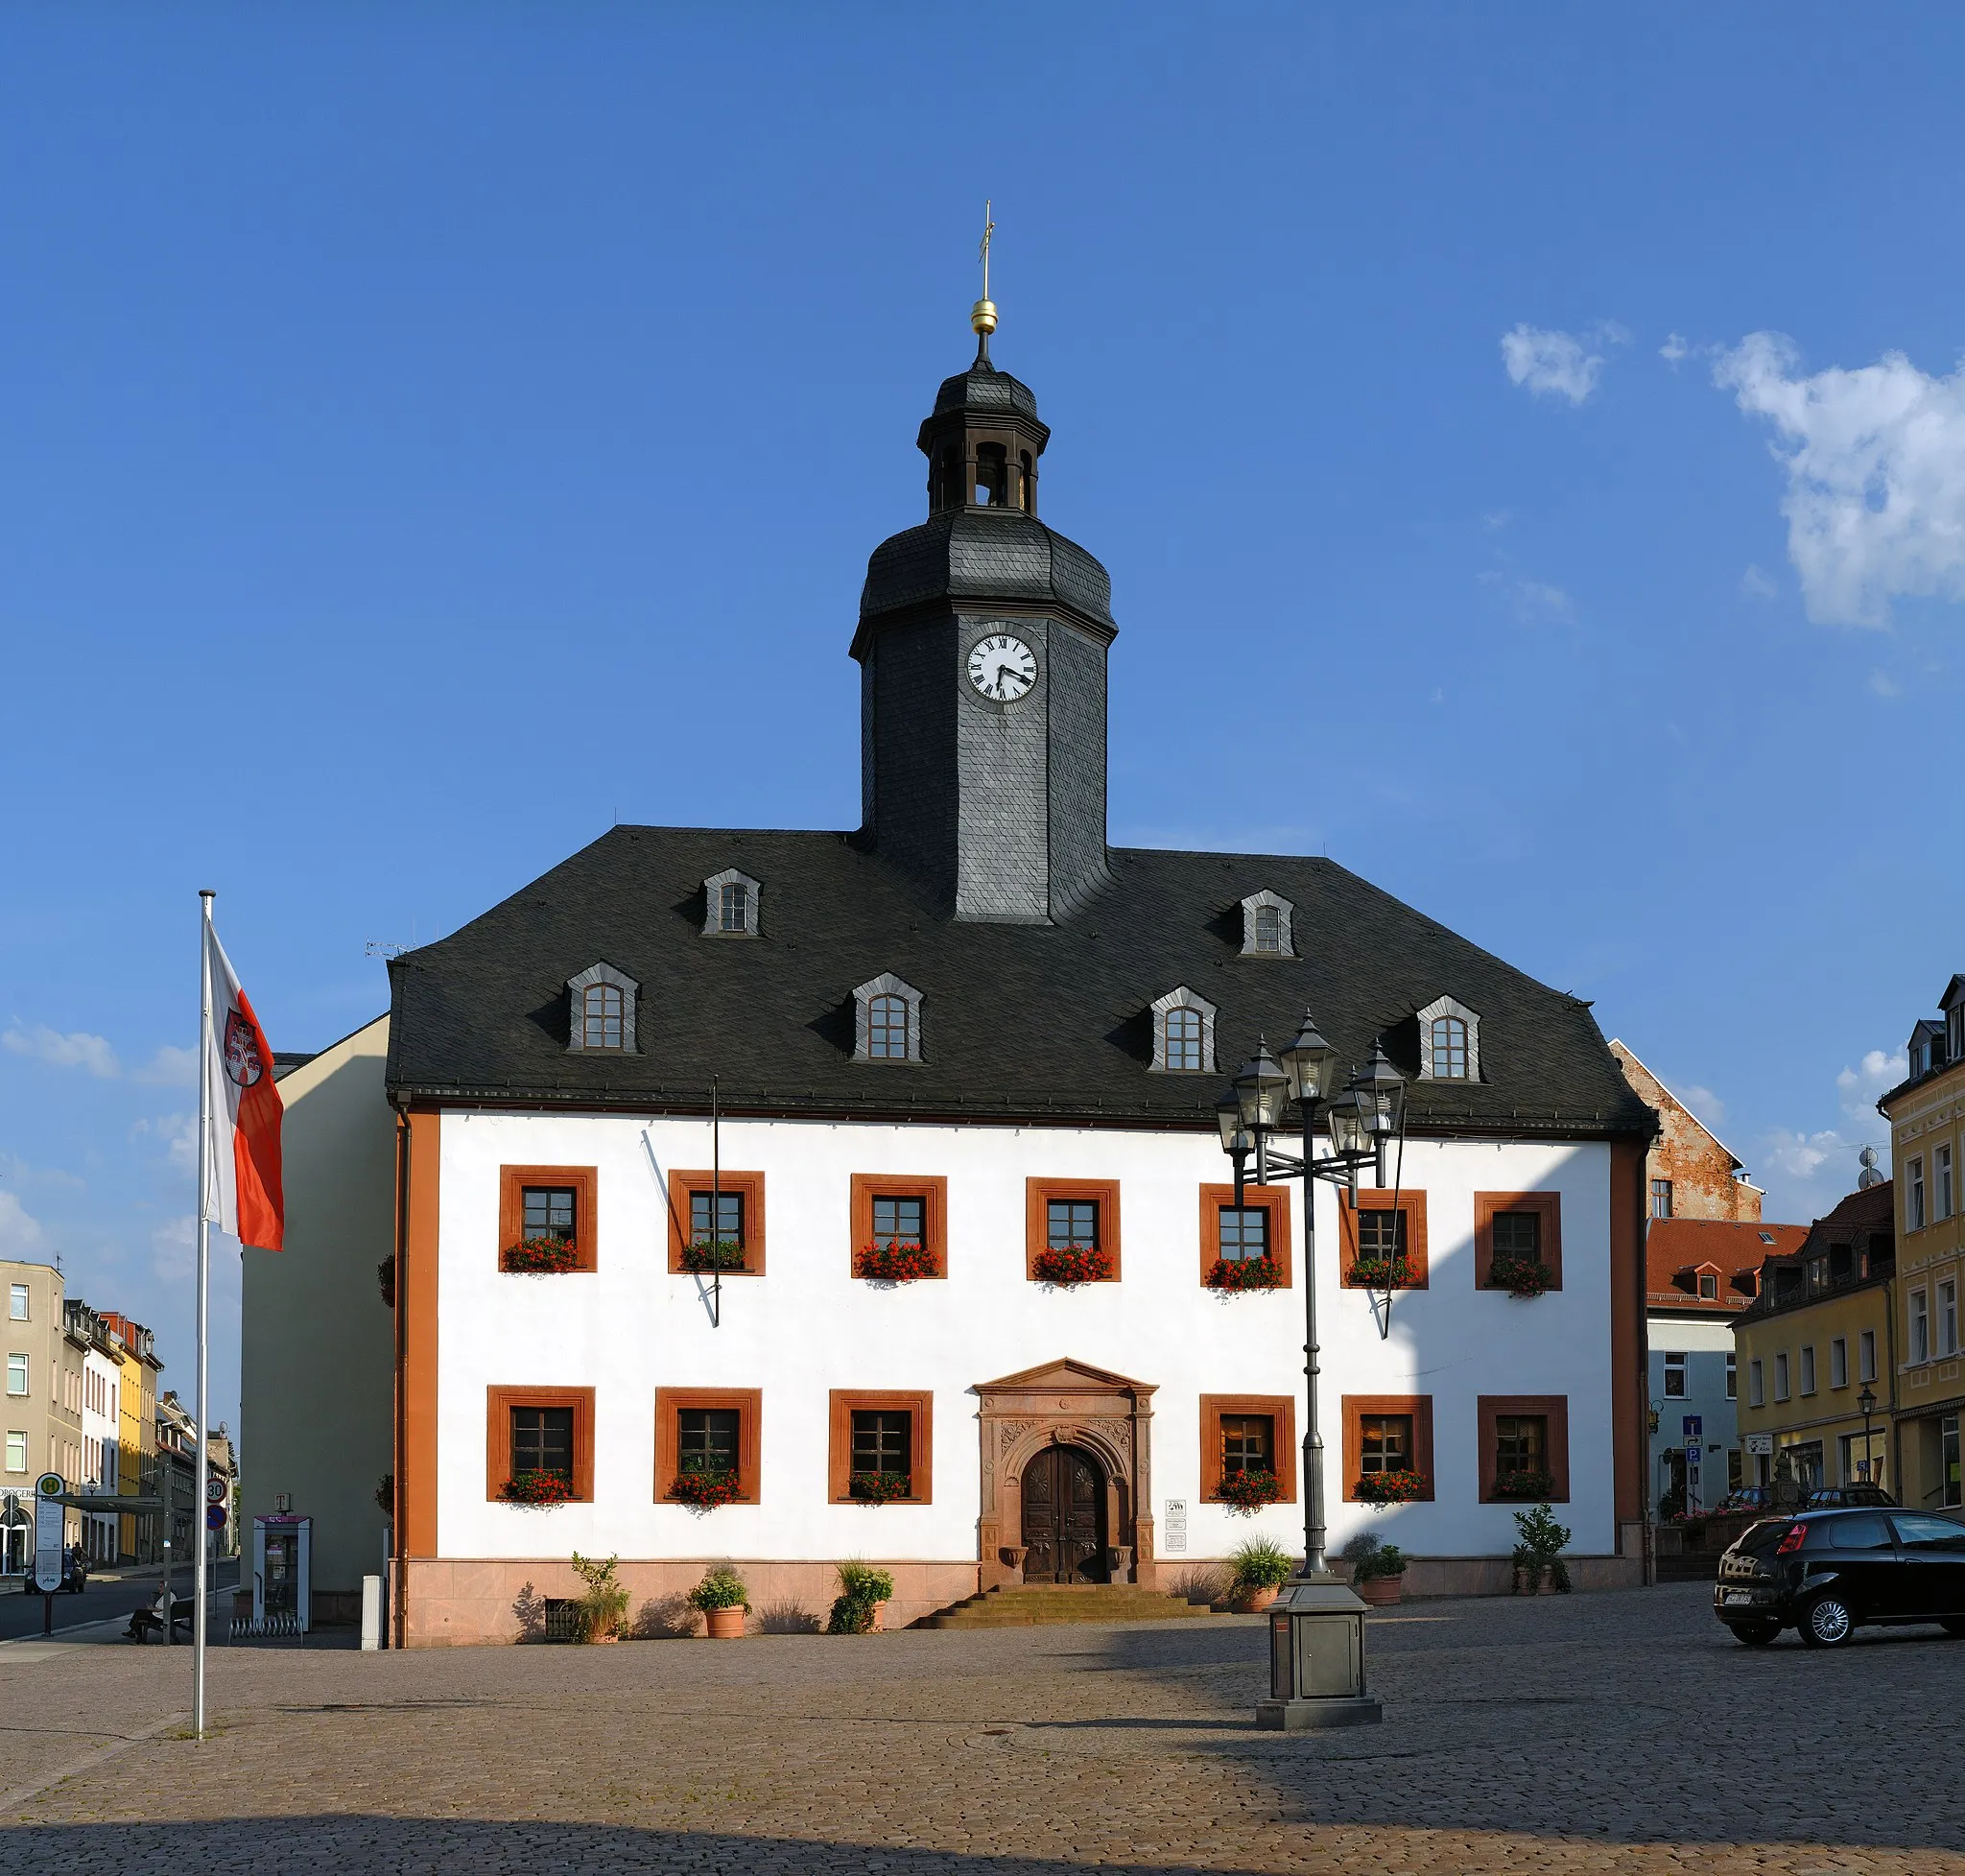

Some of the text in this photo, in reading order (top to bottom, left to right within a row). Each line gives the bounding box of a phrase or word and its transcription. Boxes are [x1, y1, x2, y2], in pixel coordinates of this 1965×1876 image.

[983, 640, 995, 652] XI
[998, 638, 1007, 649] XII
[1012, 642, 1020, 653] I
[974, 650, 985, 659] X
[1020, 653, 1031, 661] II
[1012, 686, 1021, 697] V
[207, 1484, 223, 1497] 30
[275, 1495, 286, 1510] T
